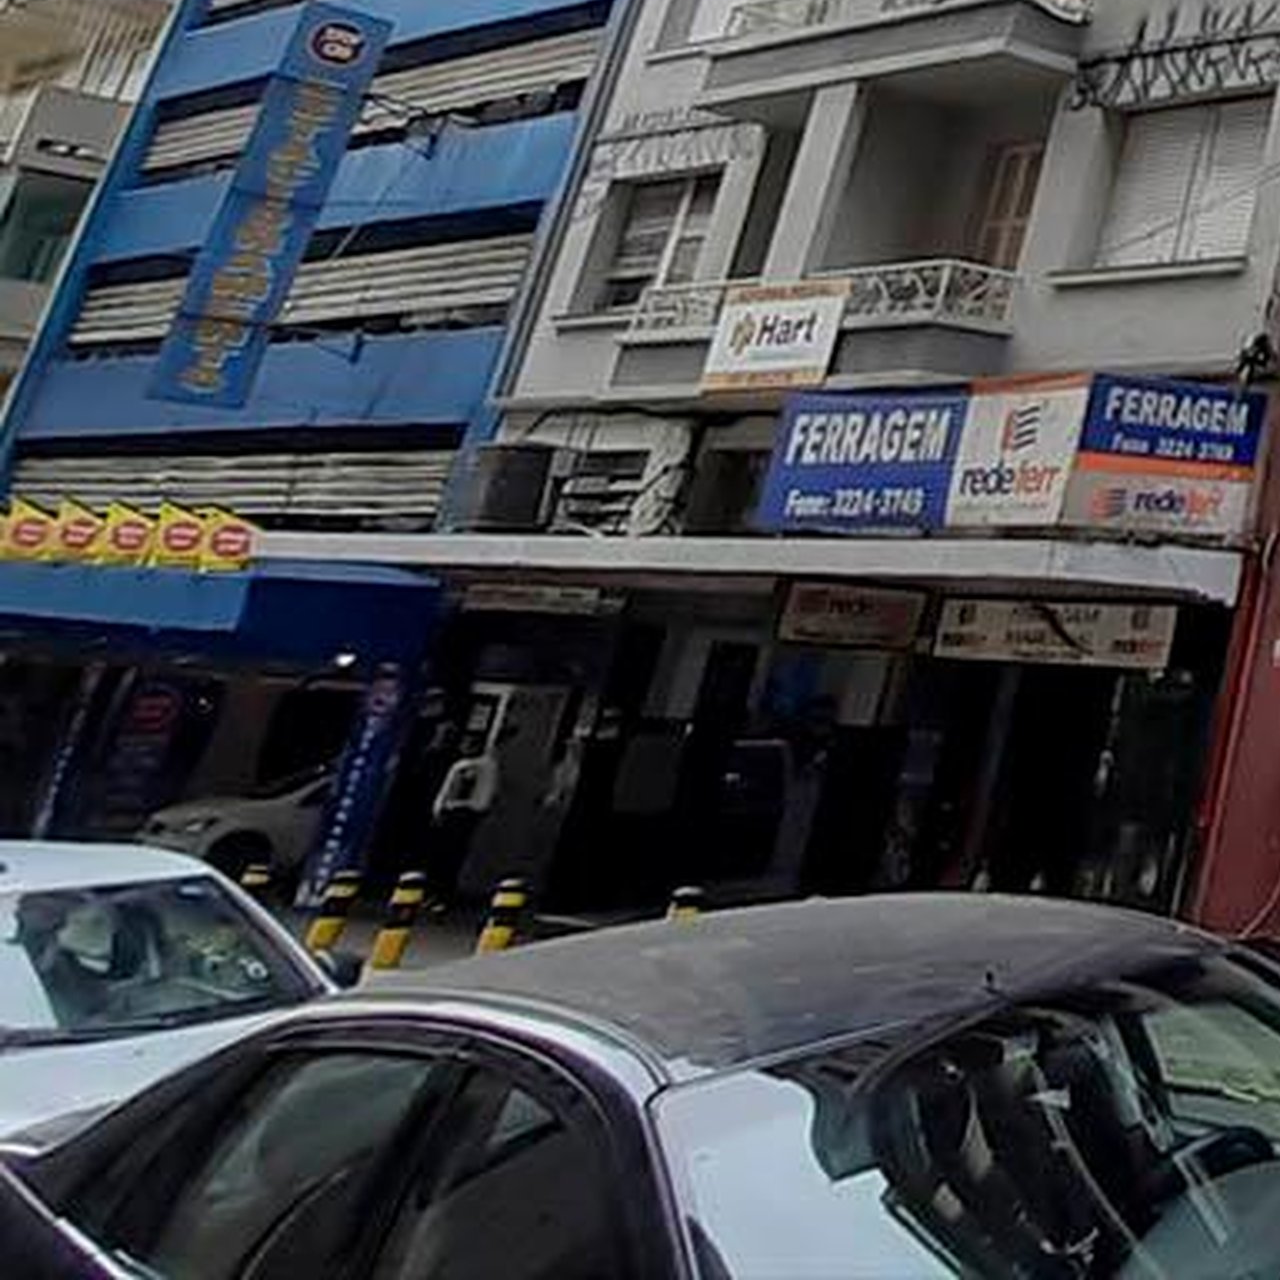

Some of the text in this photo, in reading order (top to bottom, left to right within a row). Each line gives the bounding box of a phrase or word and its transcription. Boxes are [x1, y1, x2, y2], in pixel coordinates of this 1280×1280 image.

[756, 311, 818, 347] Hart
[1105, 386, 1249, 434] FERRAGEM
[784, 406, 951, 464] FERRAGEM
